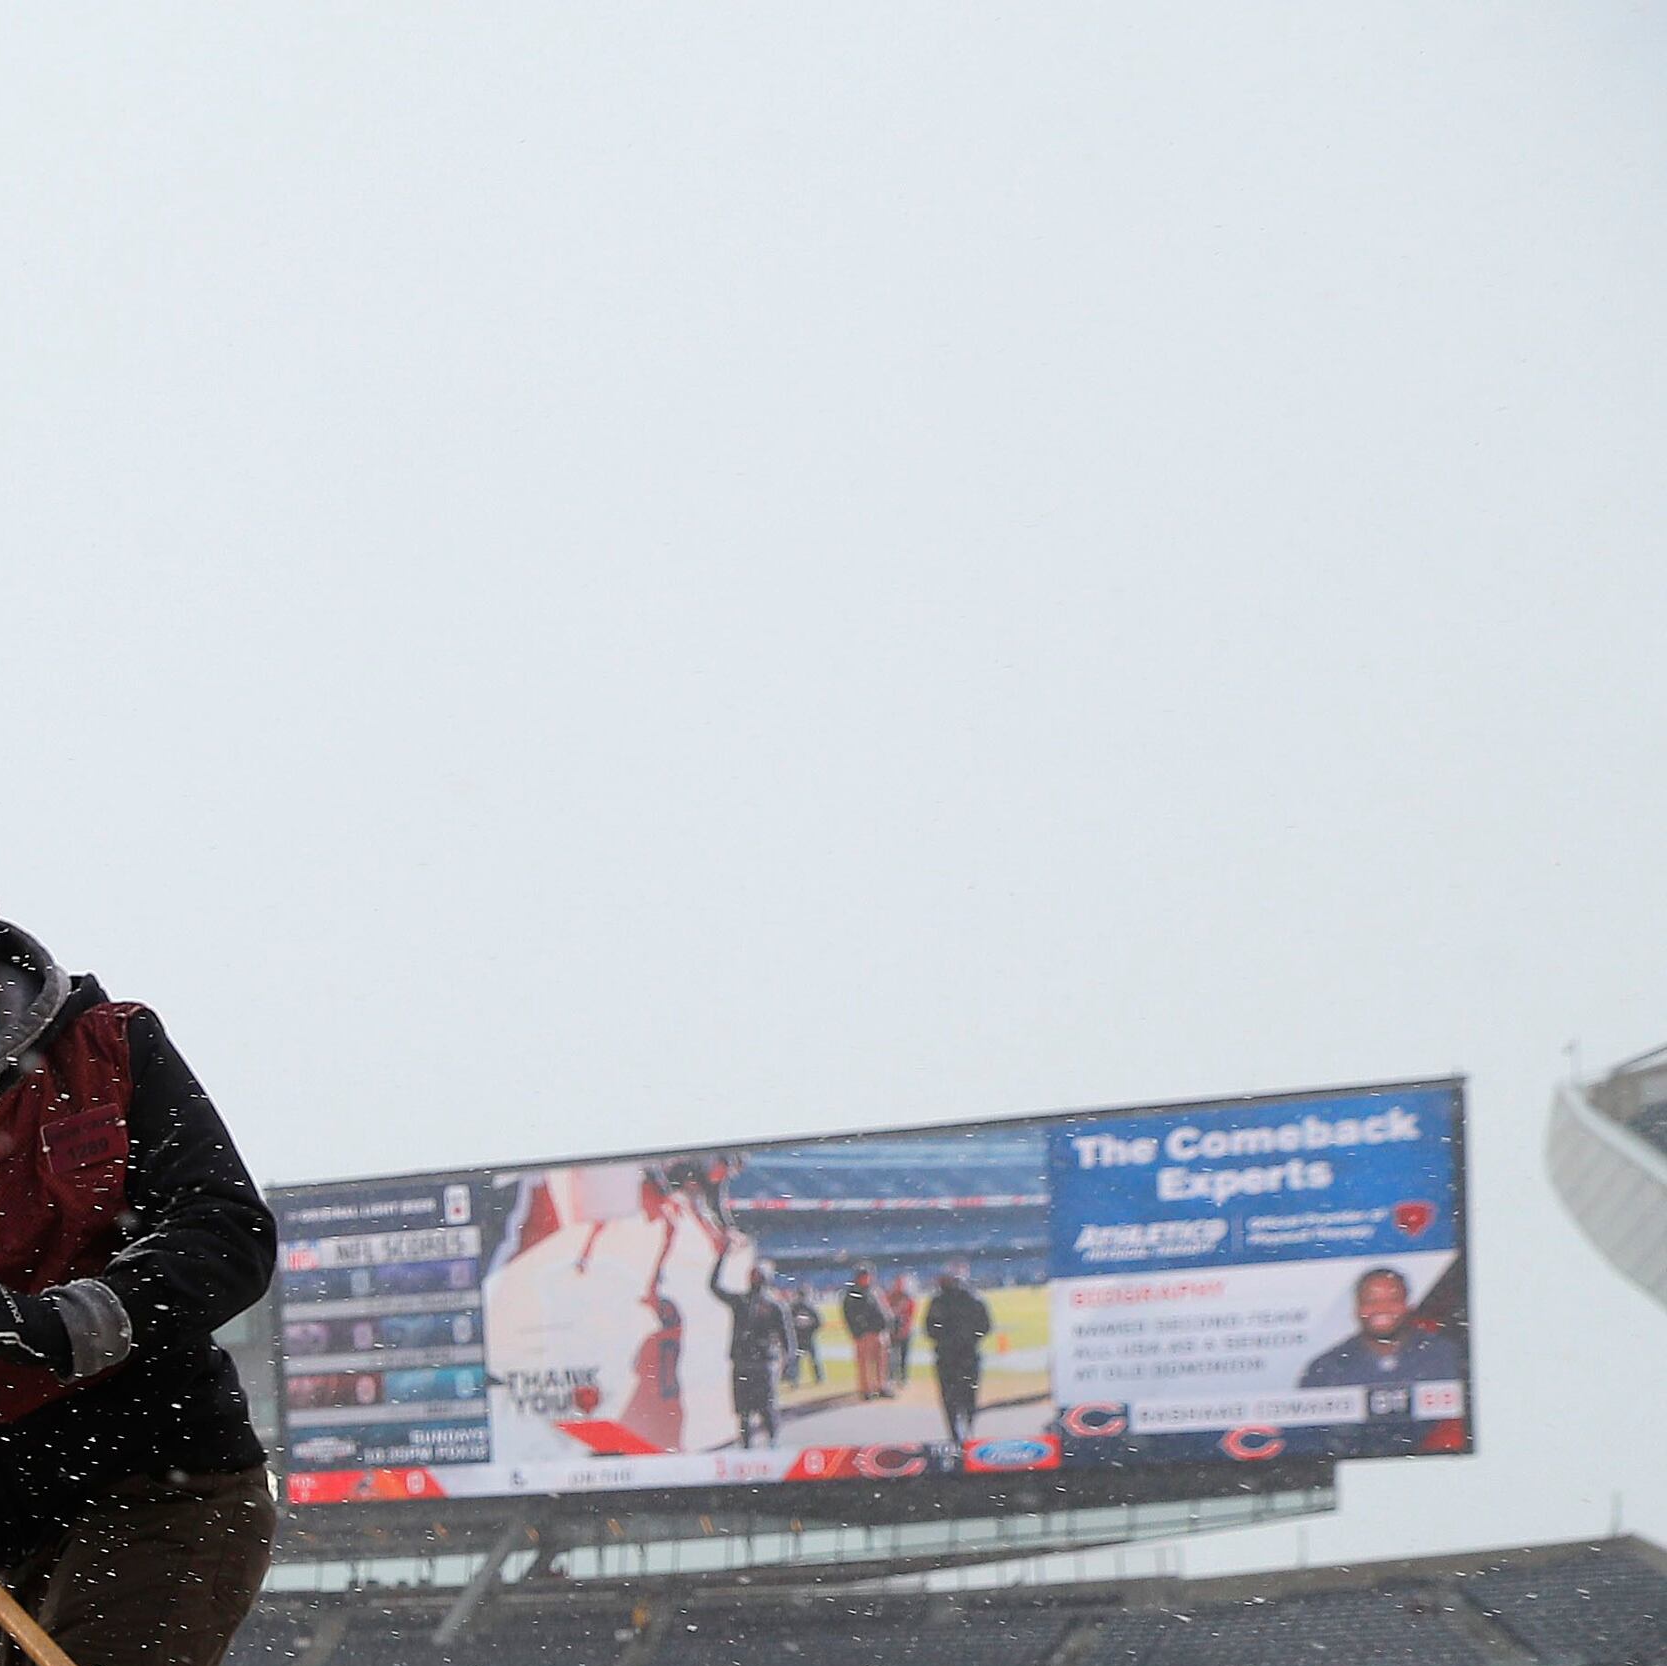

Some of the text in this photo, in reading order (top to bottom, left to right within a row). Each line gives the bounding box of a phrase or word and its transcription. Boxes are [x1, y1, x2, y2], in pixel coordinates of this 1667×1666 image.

[1073, 1107, 1420, 1169] The Comeback
[1156, 1159, 1333, 1207] Experts
[506, 1368, 599, 1390] THANK
